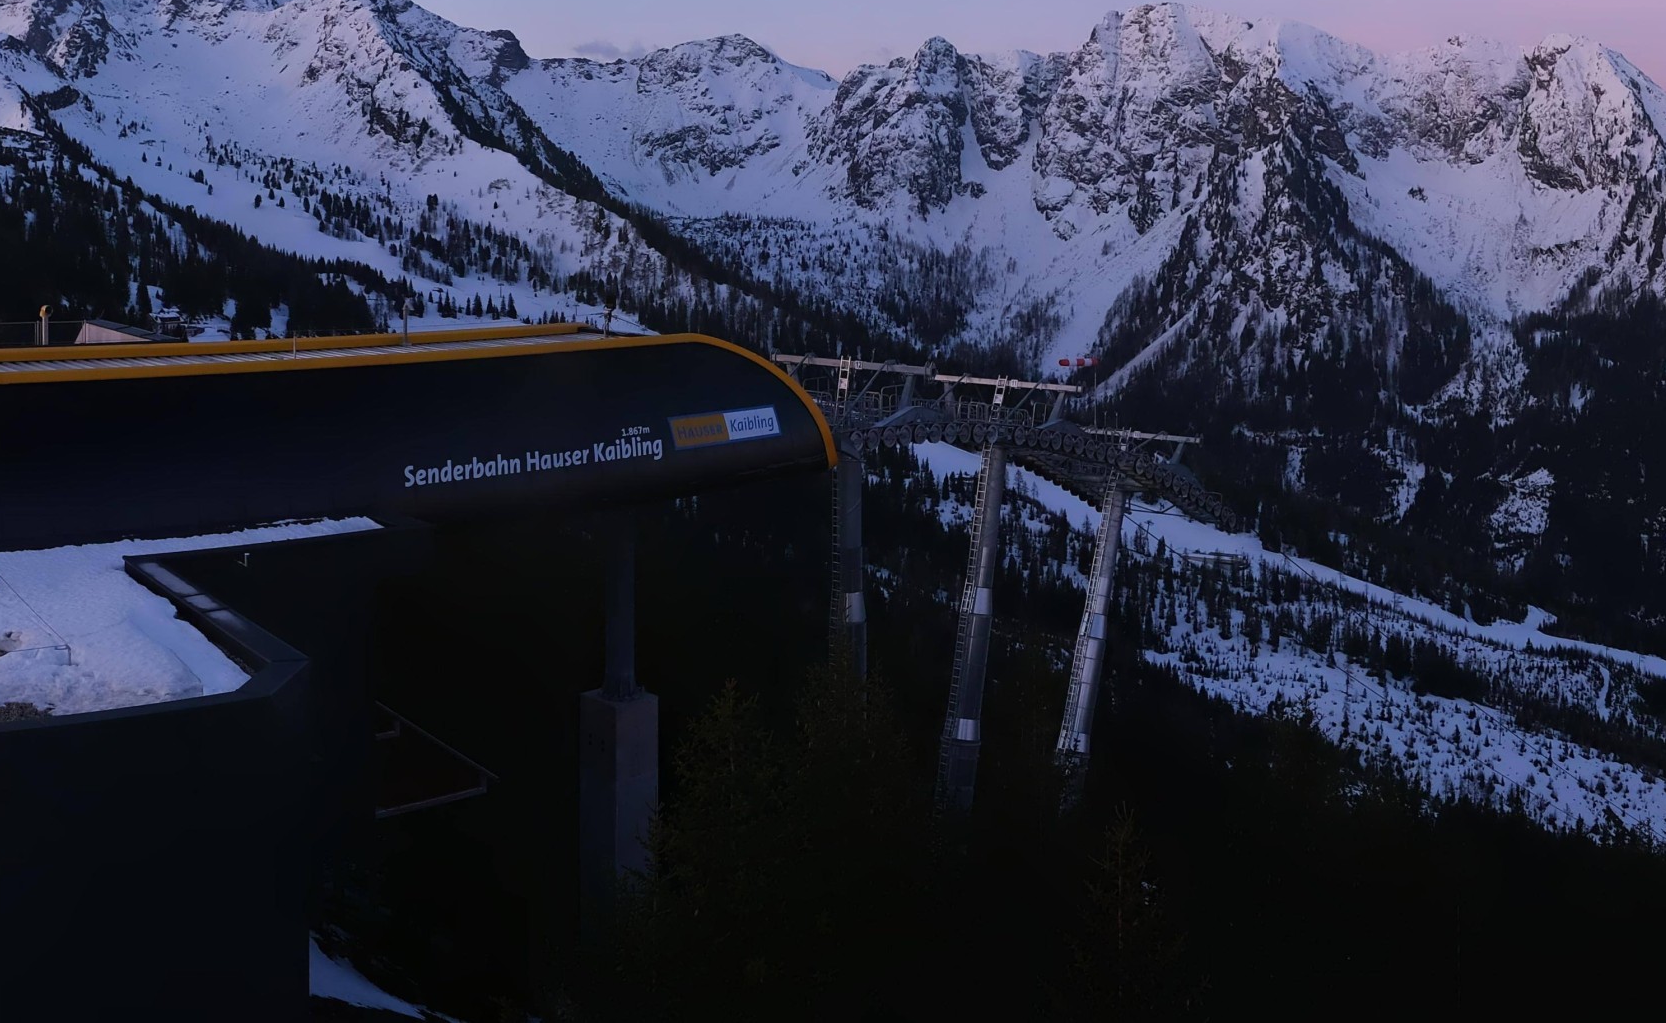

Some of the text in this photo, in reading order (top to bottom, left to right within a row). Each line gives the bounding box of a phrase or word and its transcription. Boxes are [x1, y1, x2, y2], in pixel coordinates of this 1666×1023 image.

[620, 425, 650, 437] 1.867m
[730, 415, 774, 432] Kaibling
[404, 436, 663, 488] Senderbahn Hauser Kaibling
